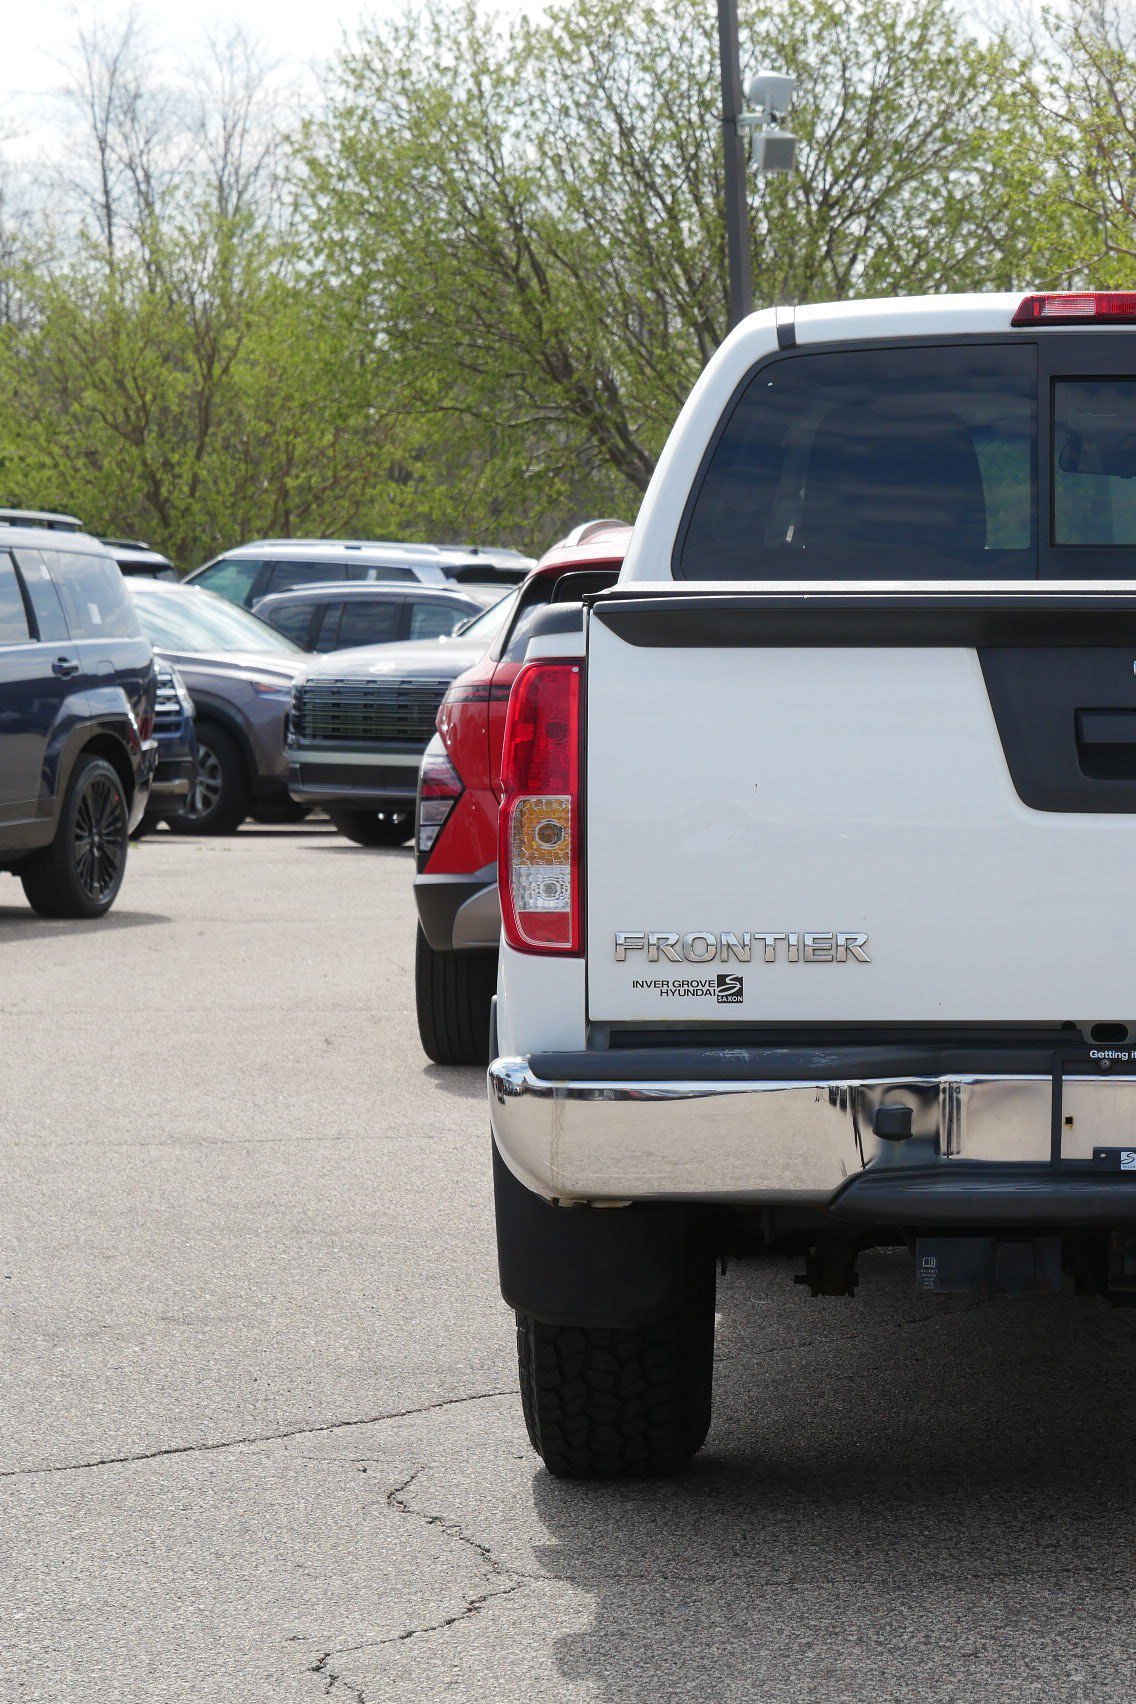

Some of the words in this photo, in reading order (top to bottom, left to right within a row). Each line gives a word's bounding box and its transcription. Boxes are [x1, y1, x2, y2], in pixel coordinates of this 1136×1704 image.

[614, 930, 872, 964] FRONTIER
[632, 980, 669, 988] INVER
[672, 980, 716, 989] GROVE
[660, 989, 716, 997] HYUNDAI
[1090, 1050, 1129, 1060] Getting
